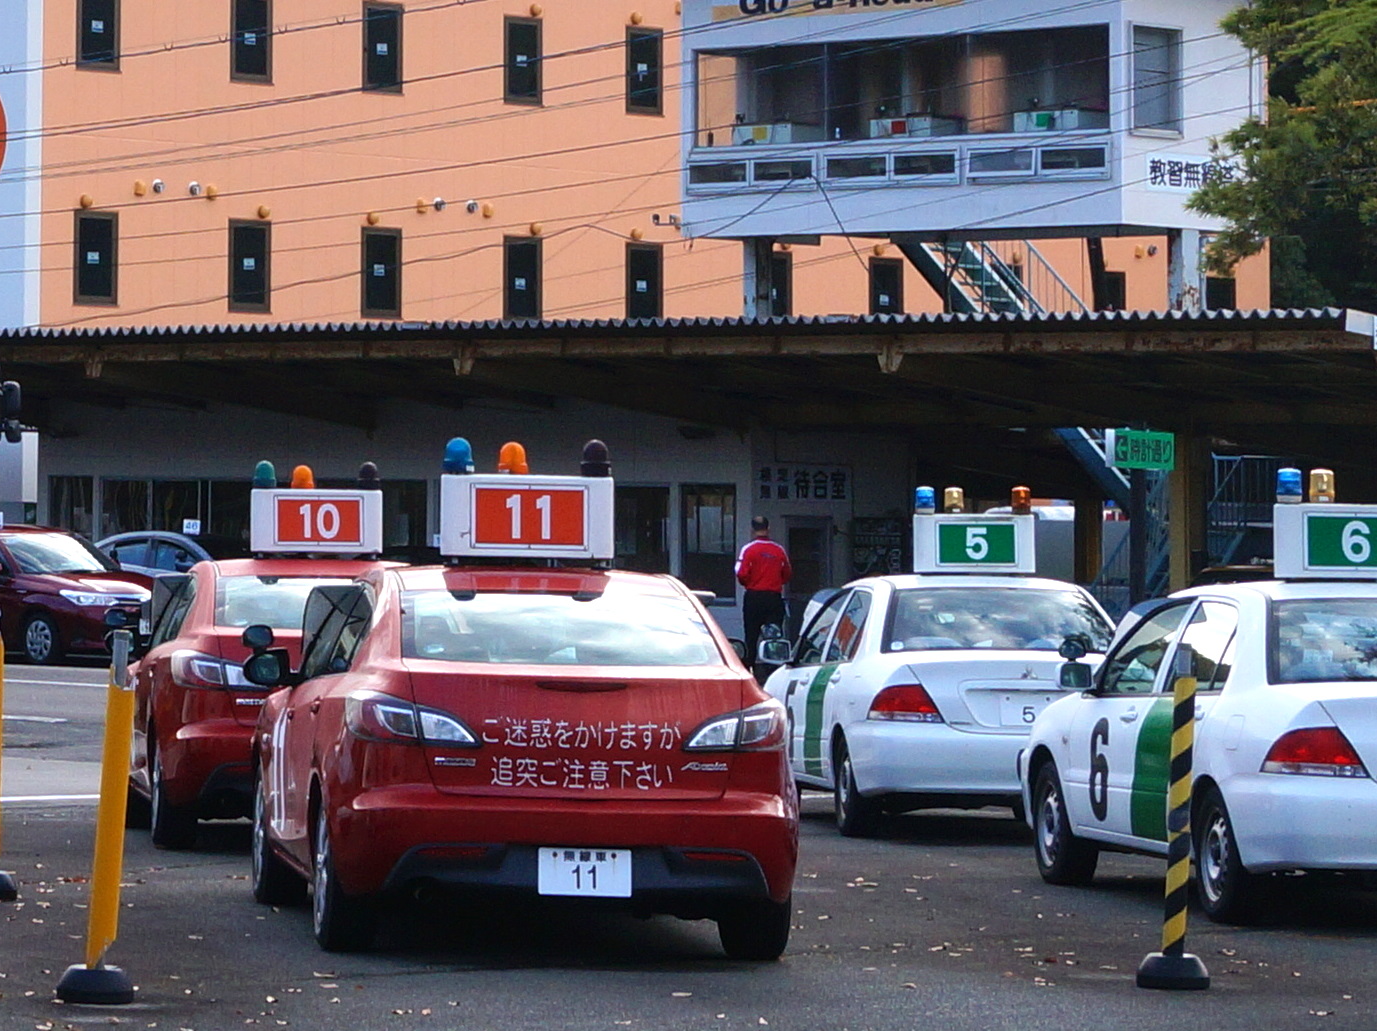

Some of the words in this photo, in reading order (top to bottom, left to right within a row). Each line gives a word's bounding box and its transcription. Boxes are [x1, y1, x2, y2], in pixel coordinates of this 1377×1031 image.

[794, 469, 846, 499] 待合室
[299, 502, 341, 539] 10
[505, 493, 552, 540] 11
[965, 526, 989, 560] 5
[1341, 520, 1371, 563] 6
[1022, 706, 1036, 724] 5
[482, 717, 682, 750] ご迷惑をかけますが
[491, 756, 673, 790] 追突ご注意下さい
[1089, 717, 1109, 822] 6
[563, 850, 607, 863] 無線車
[571, 864, 598, 890] 11
